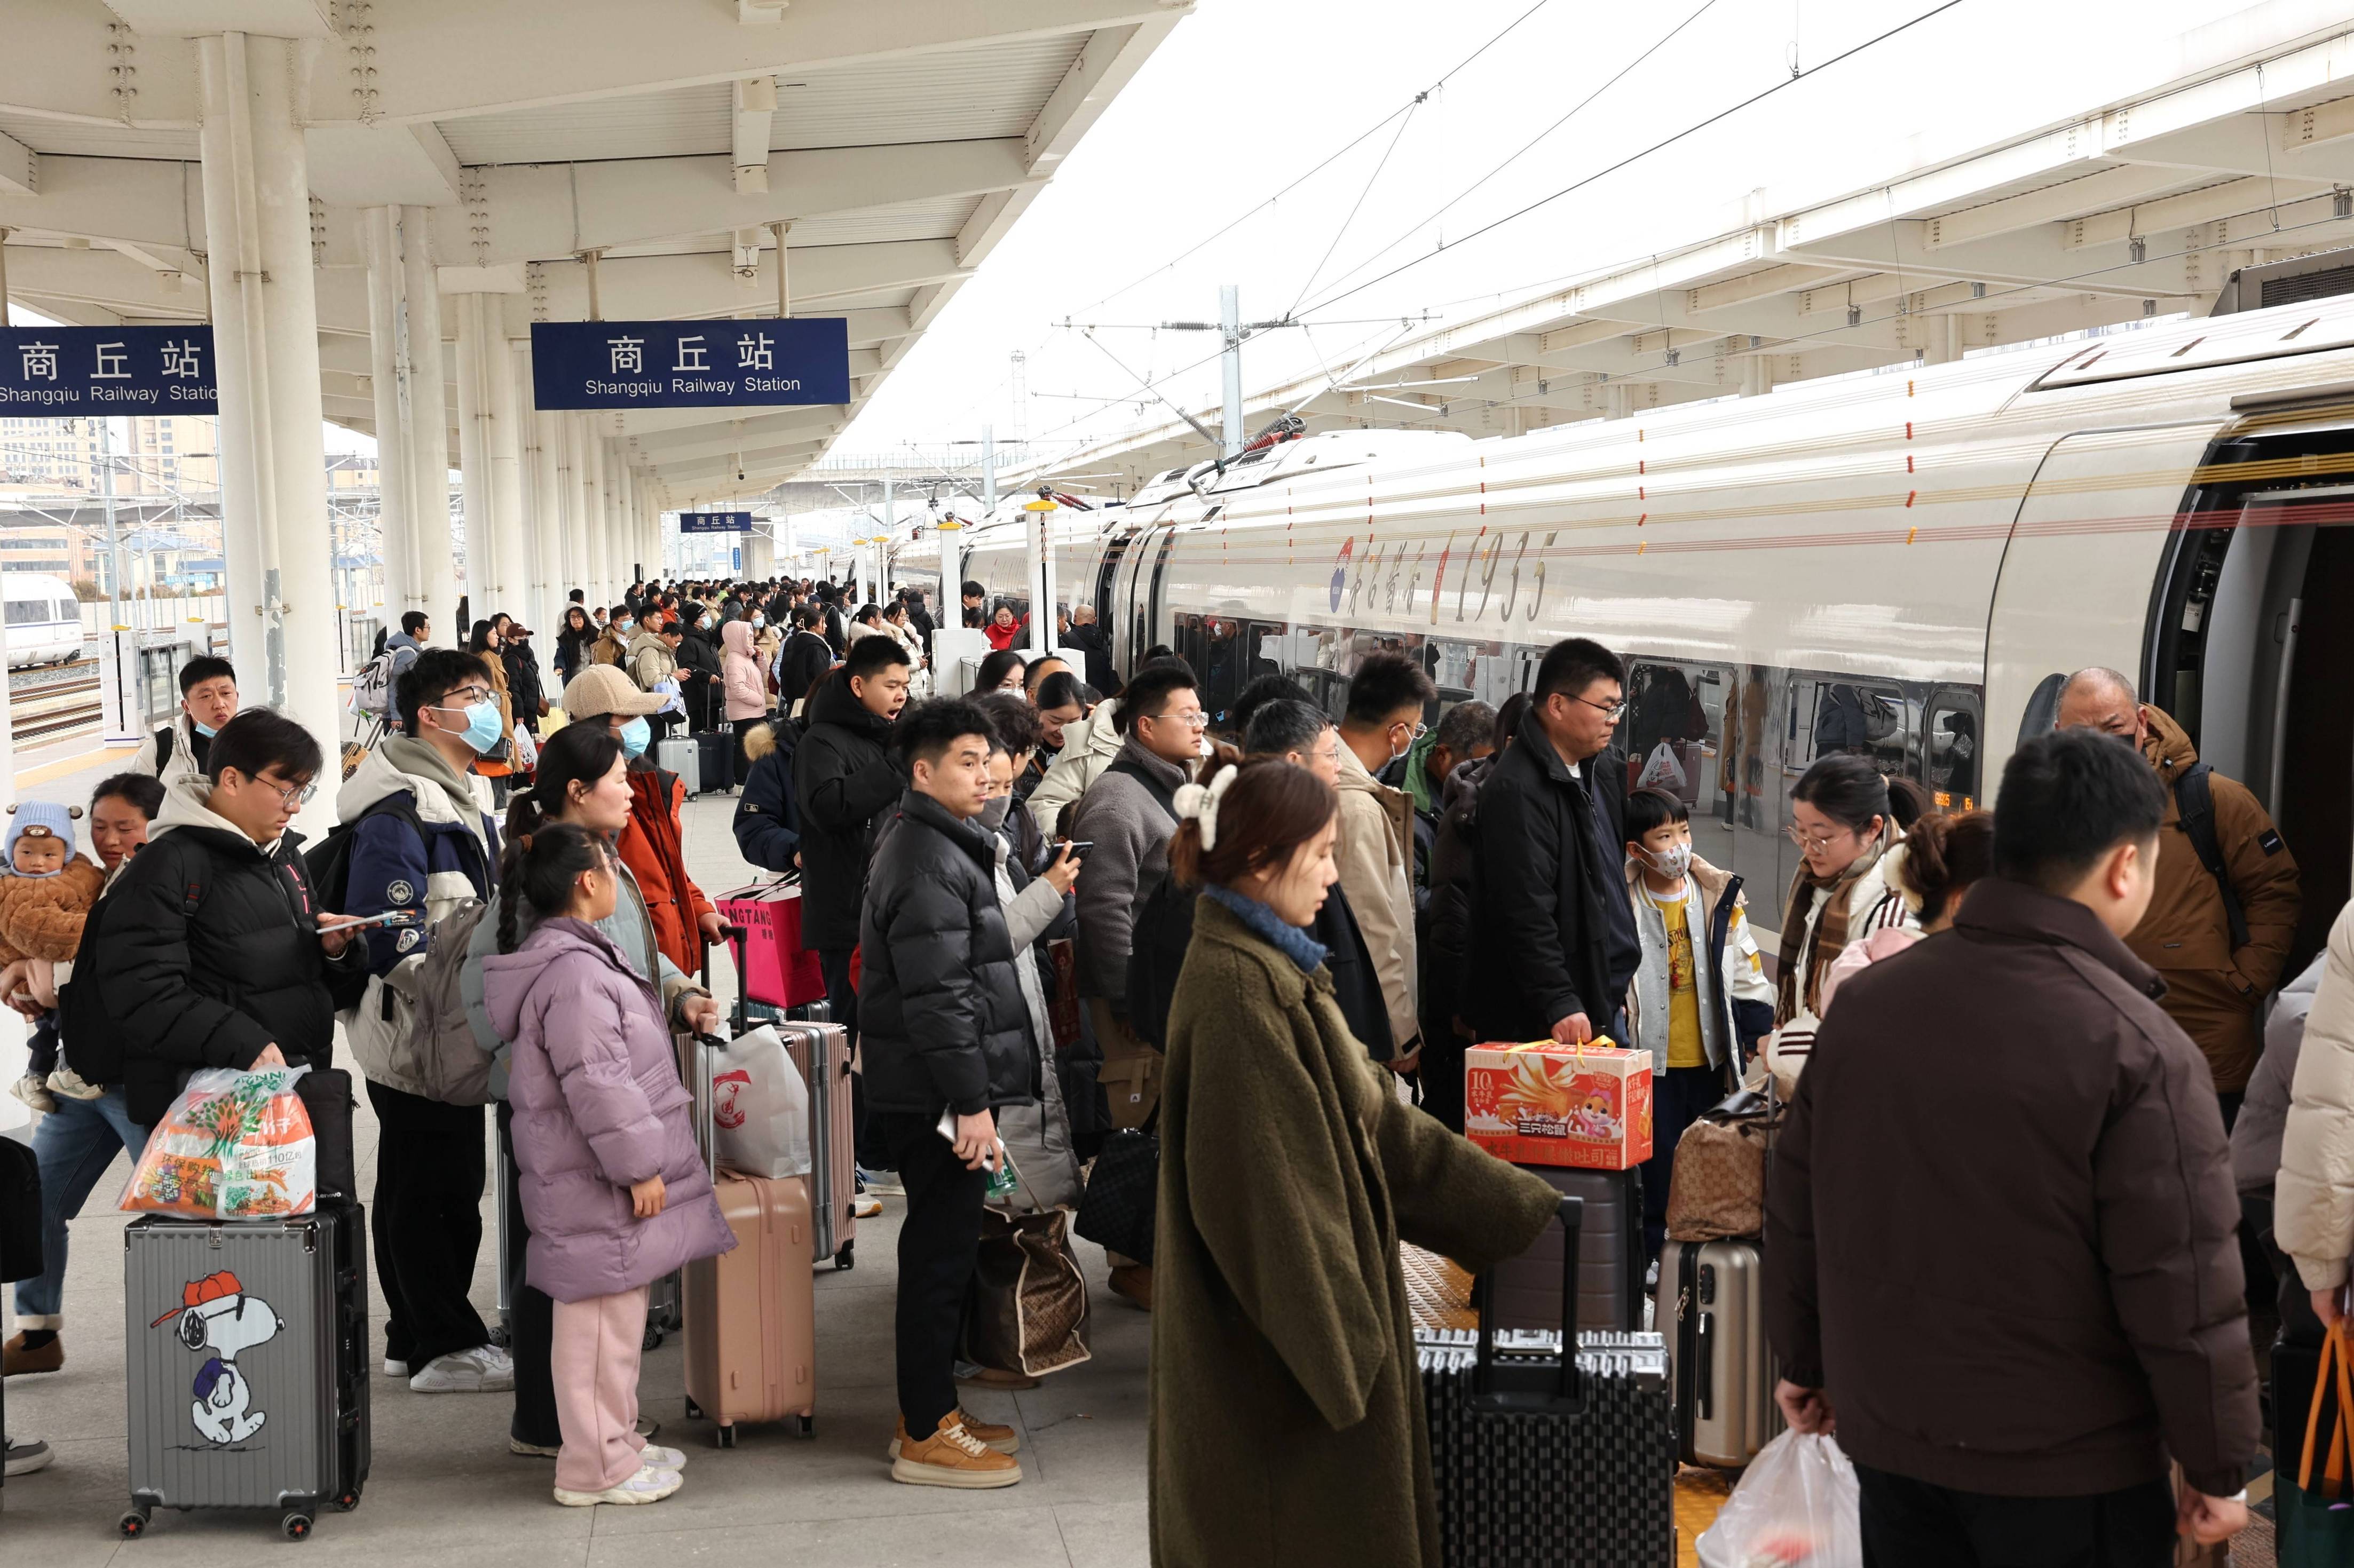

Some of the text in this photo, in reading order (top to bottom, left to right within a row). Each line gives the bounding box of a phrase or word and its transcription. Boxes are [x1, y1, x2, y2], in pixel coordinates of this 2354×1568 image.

[18, 339, 201, 381] 商丘站
[607, 332, 775, 375] 商丘站
[0, 385, 218, 405] Shangqiu Railway Statio
[586, 376, 800, 397] Shangqiu Railway Station
[697, 515, 735, 525] 商丘站
[1456, 530, 1559, 623] 1935
[720, 908, 772, 925] ANGTANG
[1519, 1122, 1567, 1136] 三只松鼠
[161, 1153, 215, 1176] 环保购物
